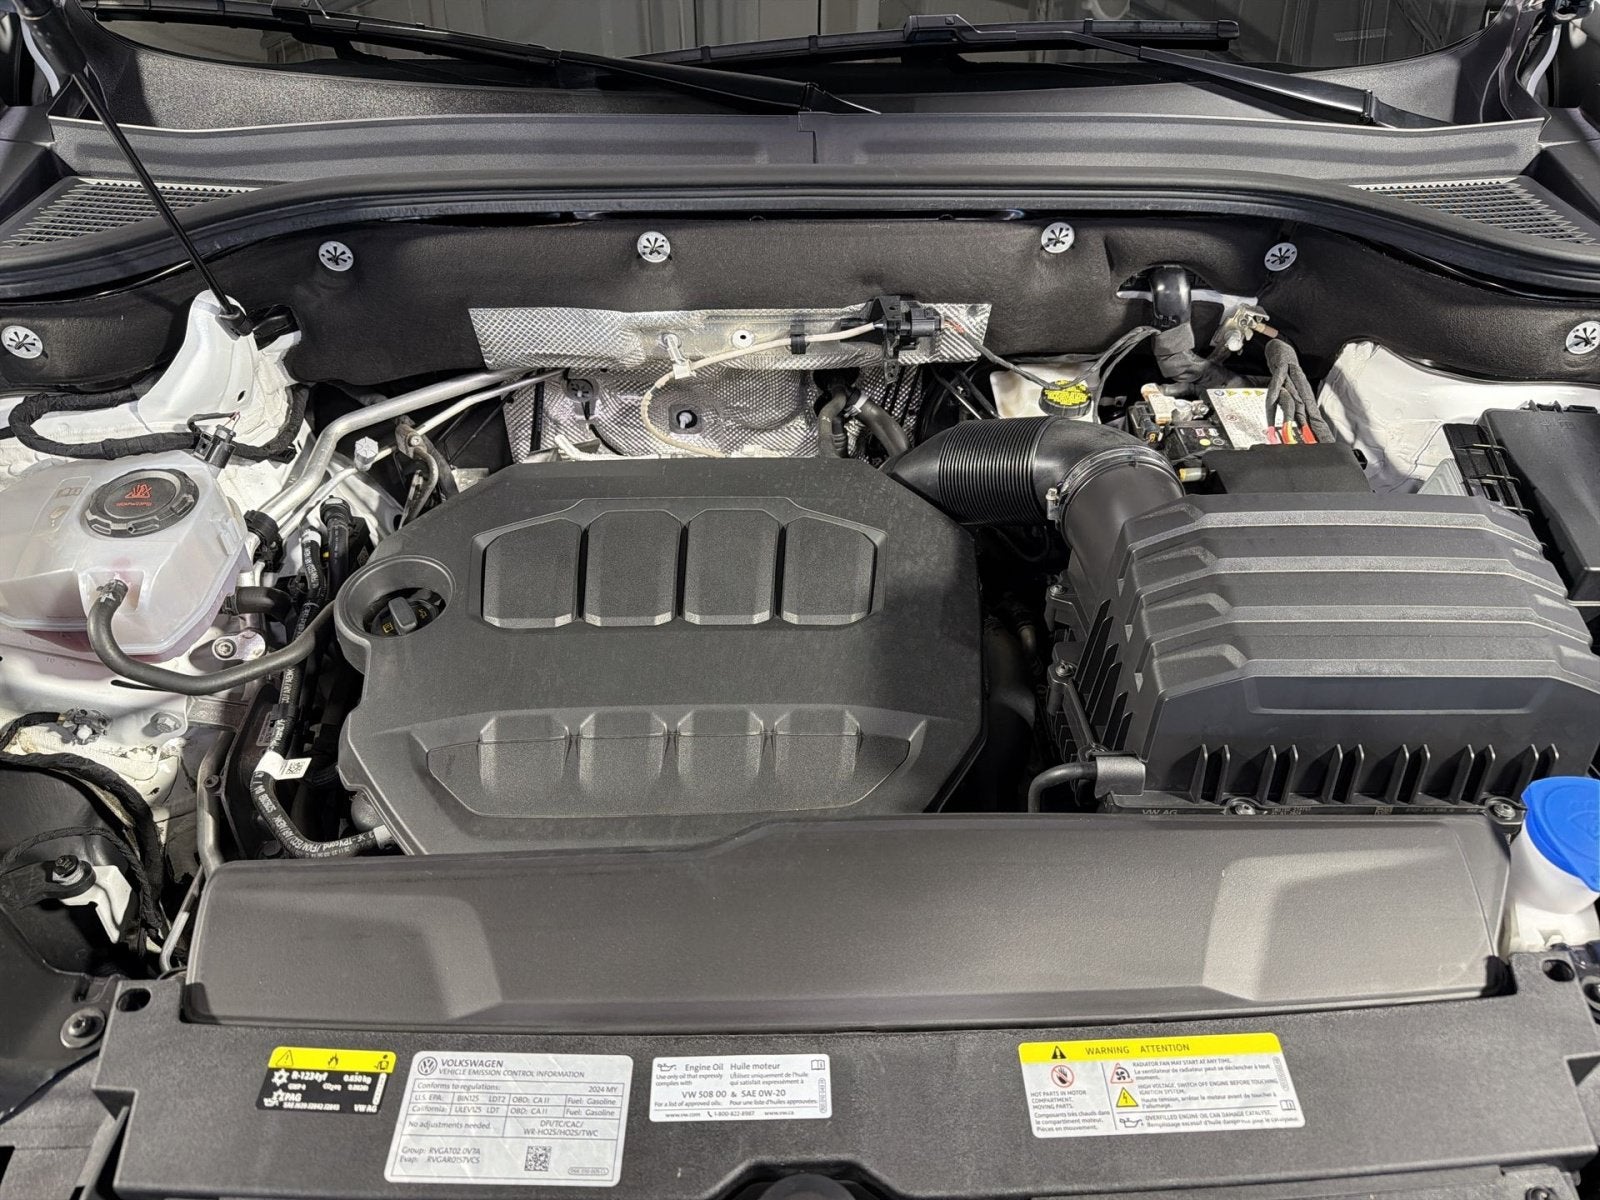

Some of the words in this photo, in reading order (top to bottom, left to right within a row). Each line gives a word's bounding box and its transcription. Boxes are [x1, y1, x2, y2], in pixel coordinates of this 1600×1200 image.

[1085, 1046, 1130, 1055] WARNING
[1140, 1044, 1190, 1053] ATTENTION
[441, 1059, 504, 1068] VOLKSWAGEN
[685, 1064, 711, 1073] Engine
[712, 1063, 724, 1071] Oil
[291, 1071, 328, 1082] R-1234yf
[537, 1070, 585, 1078] INFORMATION
[285, 1093, 302, 1102] PAG
[699, 1090, 714, 1098] 508
[716, 1090, 727, 1098] 00
[758, 1089, 786, 1097] 0W-20
[587, 1097, 616, 1105] Gasoline
[354, 1104, 365, 1112] VW
[366, 1104, 378, 1113] AG
[419, 1121, 463, 1130] adjustments
